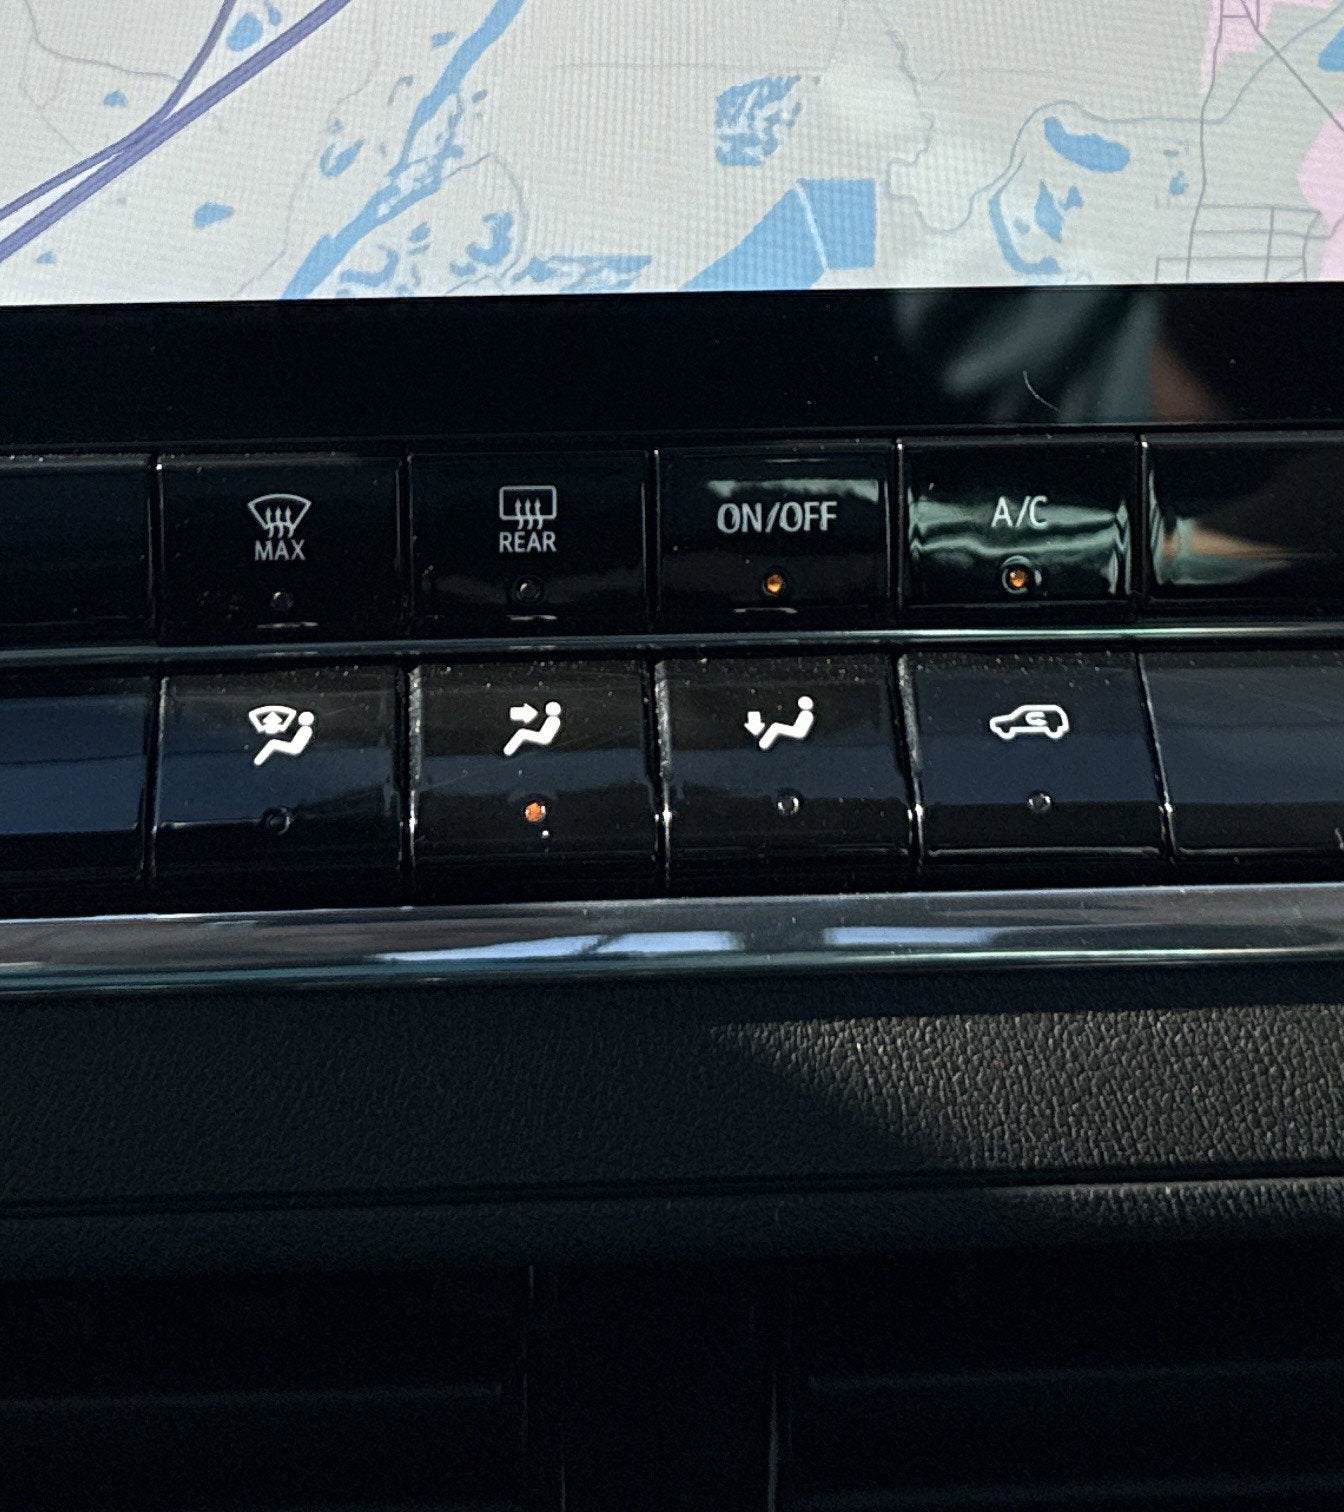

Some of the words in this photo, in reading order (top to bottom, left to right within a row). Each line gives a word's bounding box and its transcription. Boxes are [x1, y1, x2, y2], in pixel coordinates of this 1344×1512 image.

[717, 501, 837, 535] ON/OFF
[991, 496, 1048, 530] A/C
[255, 540, 306, 561] MAX
[499, 532, 556, 552] REAR
